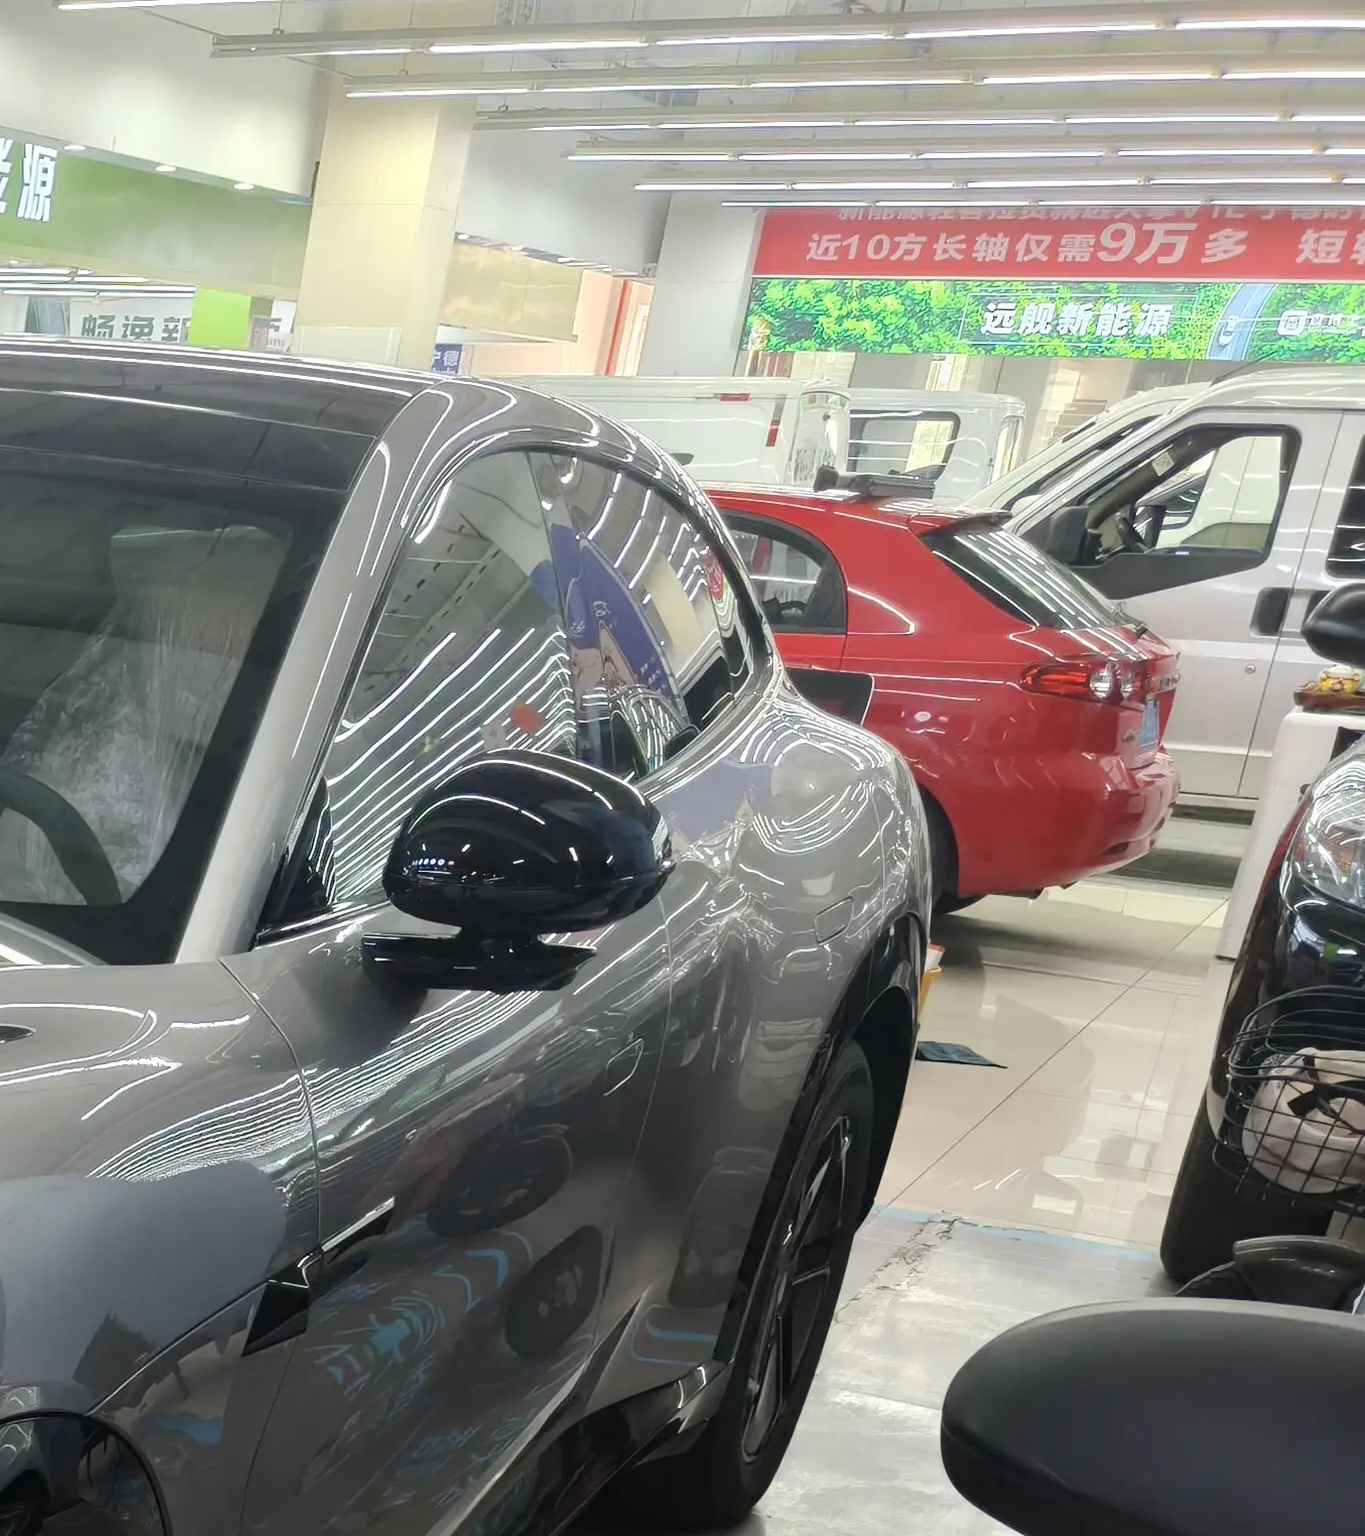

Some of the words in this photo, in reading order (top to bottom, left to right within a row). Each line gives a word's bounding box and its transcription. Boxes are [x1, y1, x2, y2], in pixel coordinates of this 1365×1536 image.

[980, 302, 1173, 338] 远舰新能源
